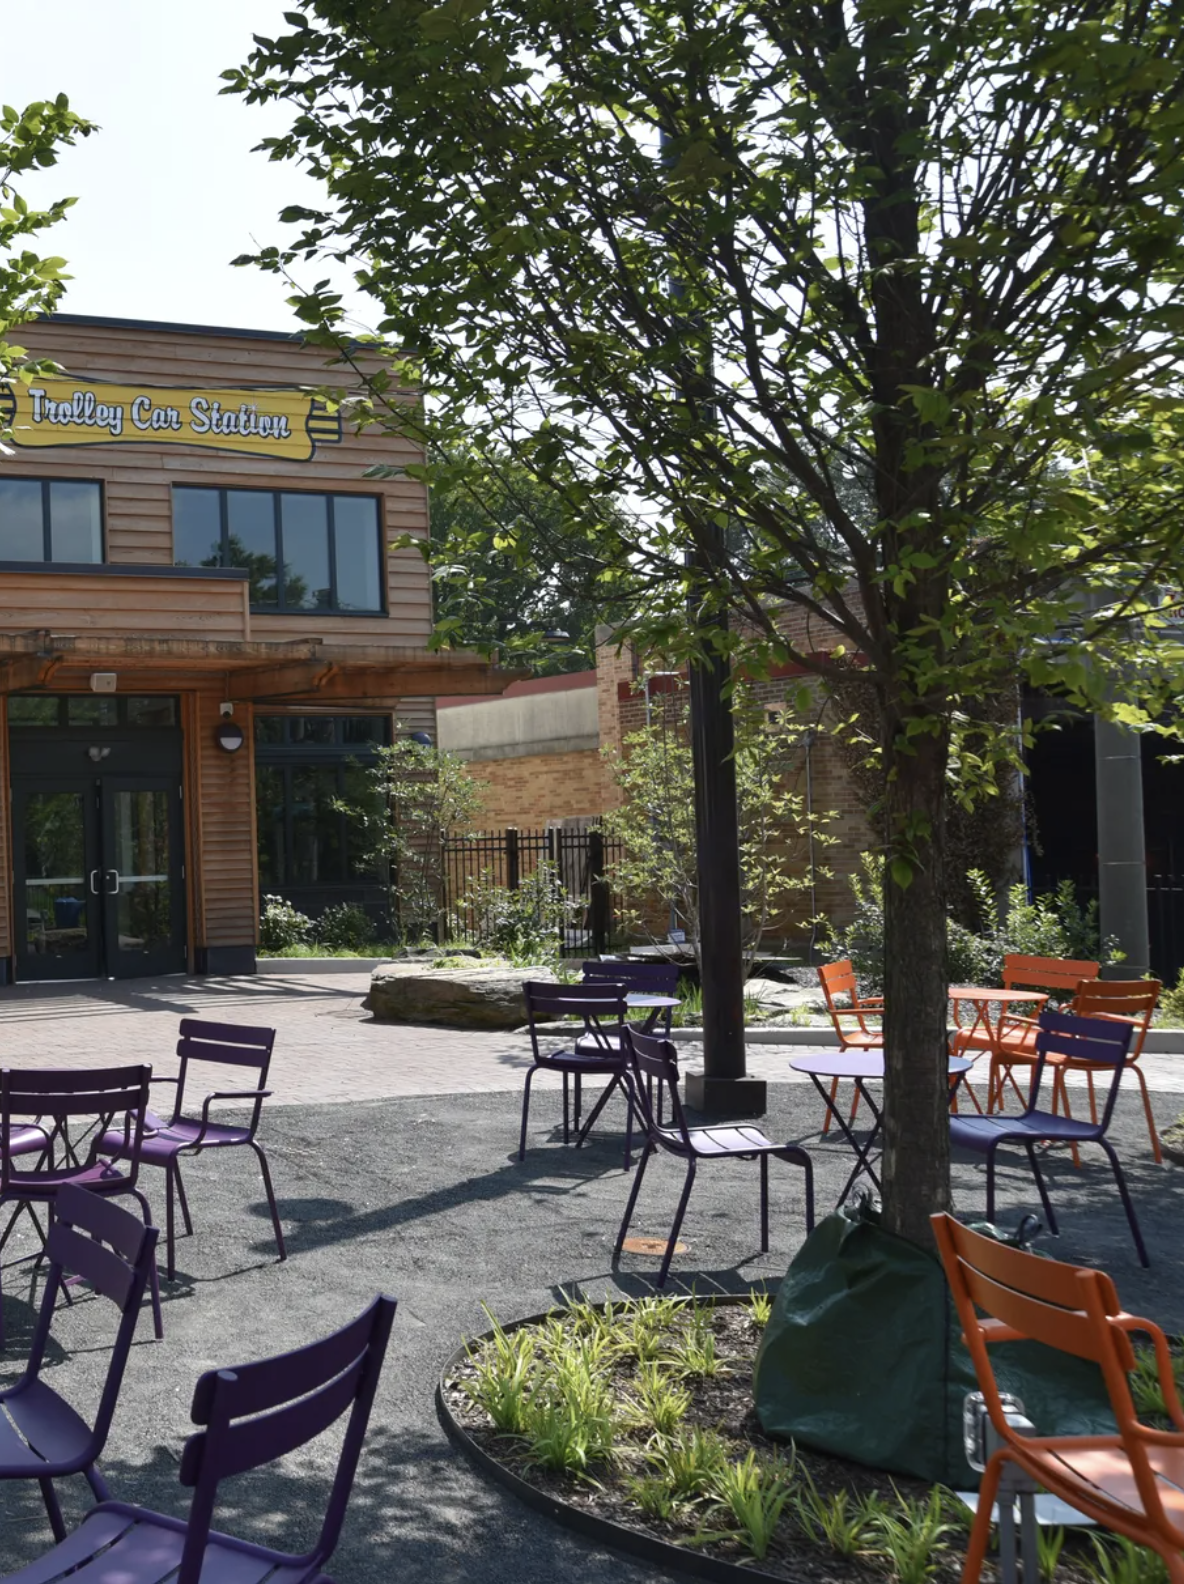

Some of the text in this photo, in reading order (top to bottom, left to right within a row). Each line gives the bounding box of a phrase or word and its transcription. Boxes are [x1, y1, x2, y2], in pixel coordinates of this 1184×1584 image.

[28, 388, 291, 439] Trolley Car Station
